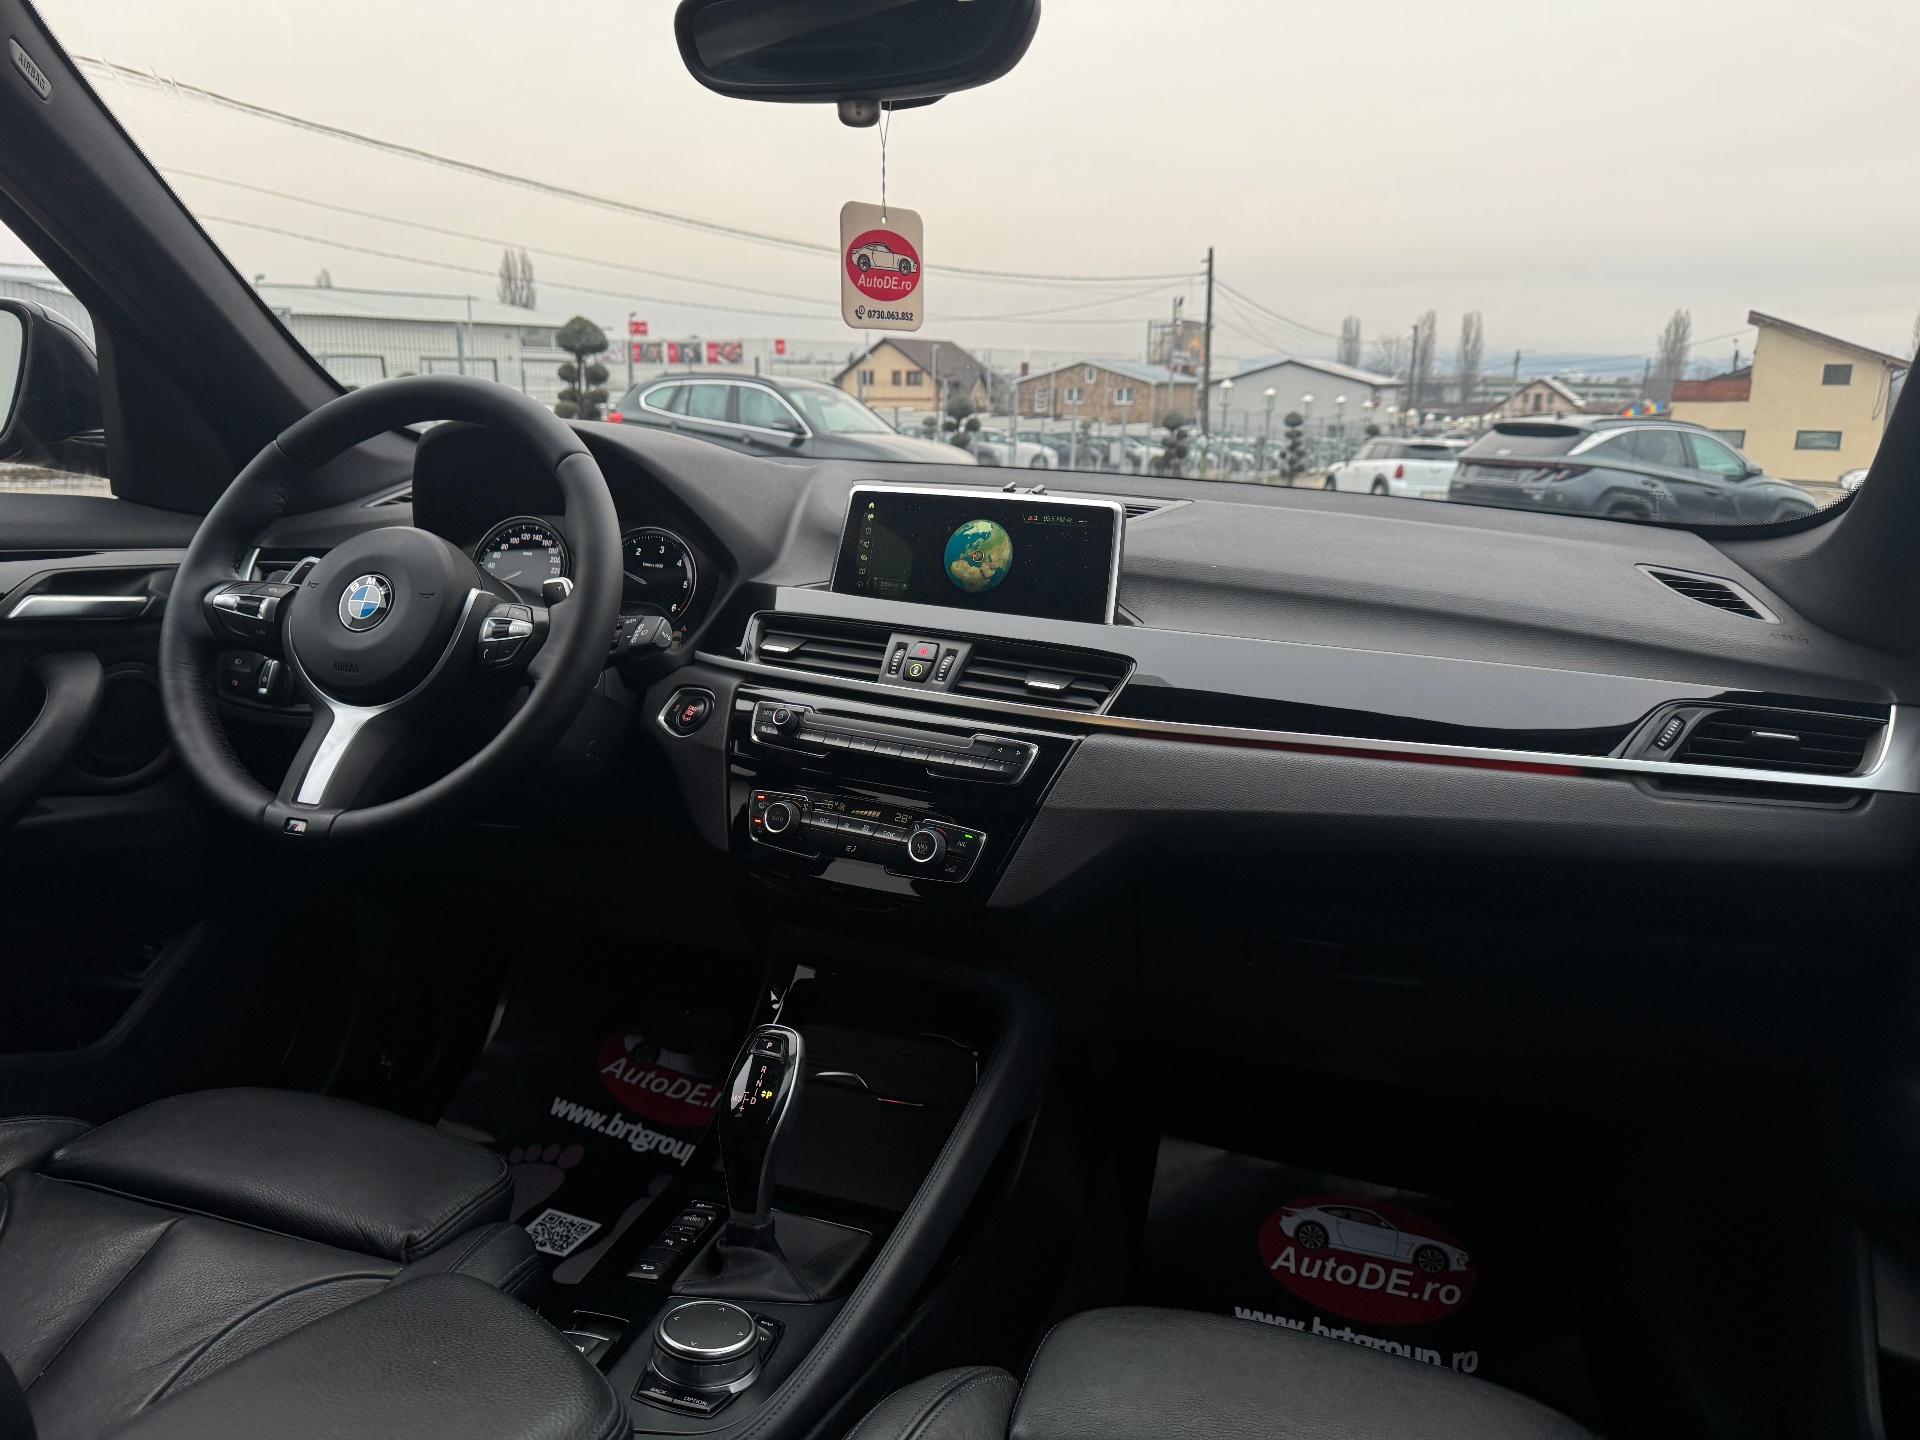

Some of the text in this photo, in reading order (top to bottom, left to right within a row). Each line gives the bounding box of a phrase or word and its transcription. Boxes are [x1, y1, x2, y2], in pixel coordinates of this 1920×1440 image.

[18, 53, 45, 91] AIRBAG
[857, 274, 912, 291] AutoDE.ro
[867, 310, 914, 321] 0730.063.852
[509, 537, 520, 545] 100
[520, 533, 531, 541] 120
[635, 548, 642, 556] 2
[659, 546, 665, 554] 3
[676, 559, 682, 567] 4
[682, 581, 688, 589] 5
[671, 604, 677, 612] 6
[766, 1041, 773, 1049] P
[761, 1065, 767, 1073] R
[756, 1079, 763, 1088] N
[750, 1096, 757, 1105] D
[1270, 1246, 1462, 1305] AutoDE.ro
[650, 1387, 667, 1395] BACK
[684, 1396, 708, 1406] OPTION
